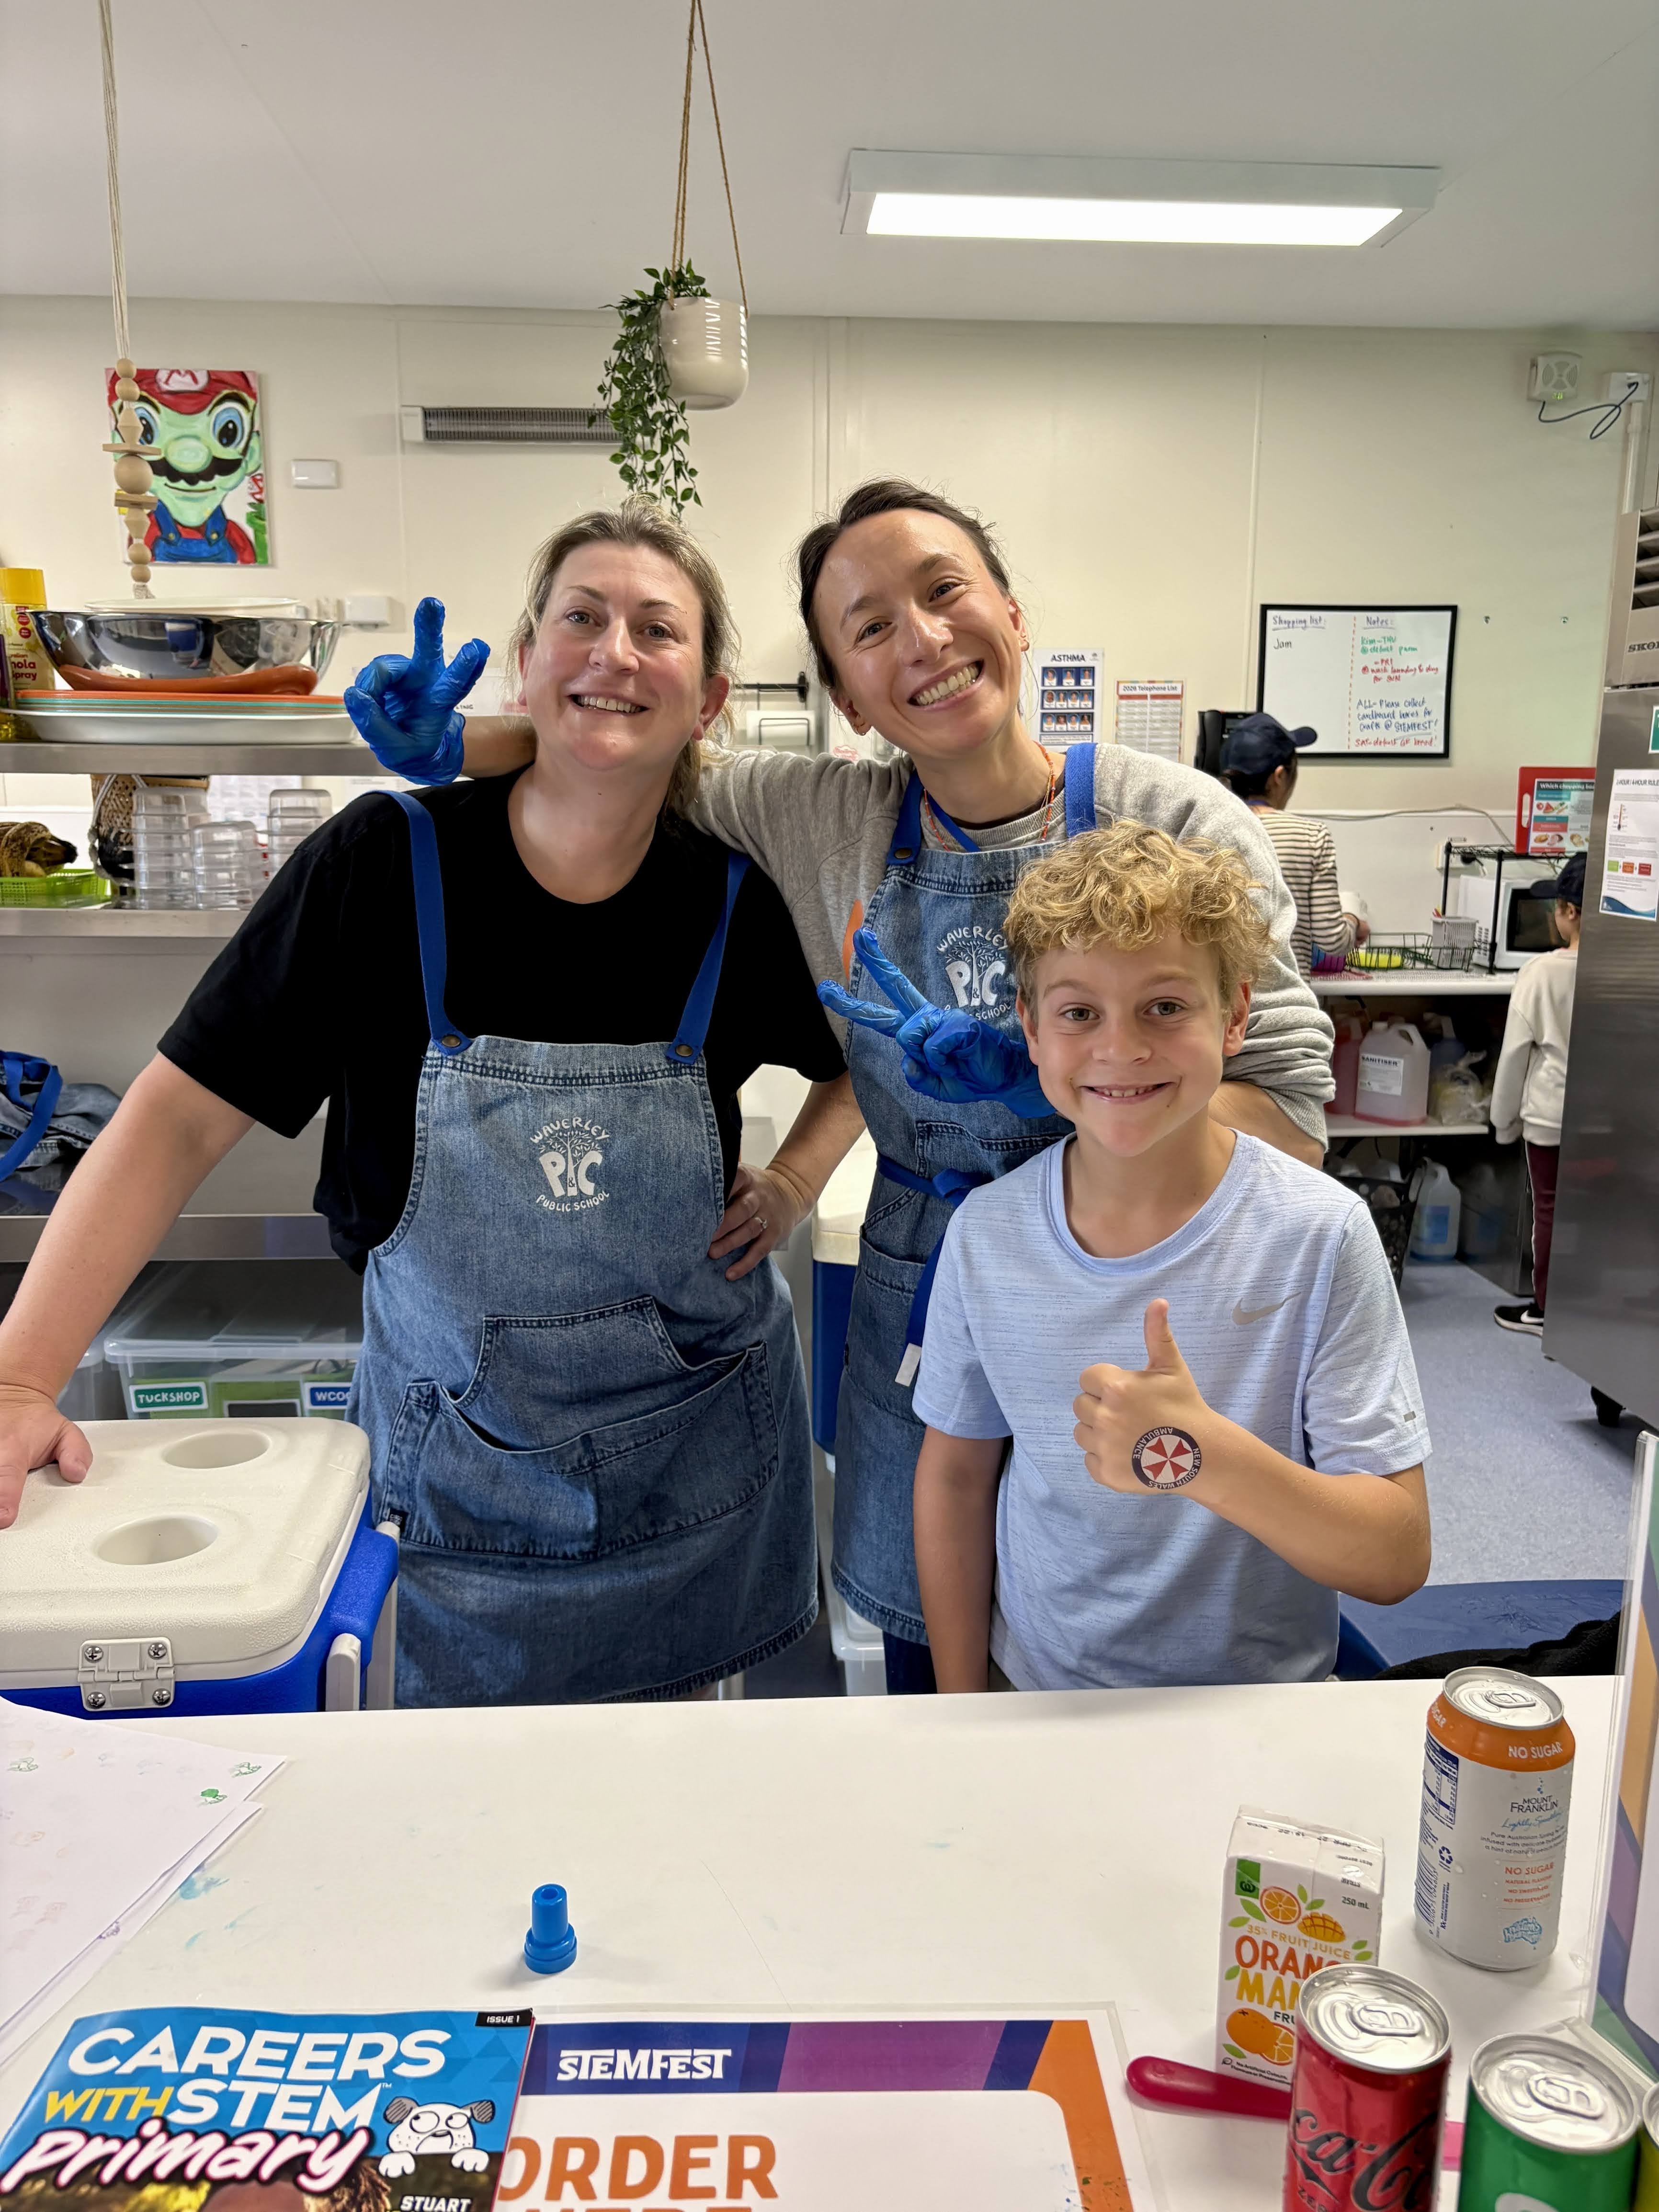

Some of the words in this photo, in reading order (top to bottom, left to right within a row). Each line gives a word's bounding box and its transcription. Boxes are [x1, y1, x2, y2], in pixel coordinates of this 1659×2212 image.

[1273, 638, 1292, 649] Jam
[1050, 654, 1086, 662] ASTHMA
[1379, 699, 1400, 708] Please
[1404, 696, 1426, 708] collect
[1357, 710, 1396, 720] cardboard
[976, 1003, 1011, 1021] SCHOOL
[530, 1117, 610, 1143] WAVERLEY
[536, 1194, 571, 1212] PUBLIC
[574, 1190, 610, 1211] SCHOOL
[137, 1391, 200, 1404] TUCKSHOP
[1133, 1427, 1173, 1459] AMBULANCE
[1176, 1467, 1198, 1487] SOUTH
[1148, 1480, 1175, 1490] WALES
[1509, 1746, 1528, 1759] NO
[1531, 1742, 1563, 1759] SUGAR
[1510, 1799, 1558, 1813] FRANKLIN
[1522, 1795, 1553, 1804] MOUNT
[1480, 1836, 1505, 1846] infused
[1505, 1867, 1522, 1875] NO
[1525, 1862, 1555, 1875] SUGAR
[1341, 1896, 1356, 1905] 250
[1358, 1900, 1370, 1909] mL
[1246, 1924, 1268, 1936] 35%
[1272, 1930, 1310, 1948] FRUIT
[1313, 1942, 1352, 1961] JUICE
[487, 2016, 514, 2024] ISSUE
[67, 2024, 452, 2081] CAREERS
[556, 2048, 732, 2081] STEMFEST
[45, 2086, 175, 2124] WITH
[166, 2078, 383, 2133] STEM
[498, 2134, 779, 2201] ORDER
[400, 2195, 472, 2212] STUART
